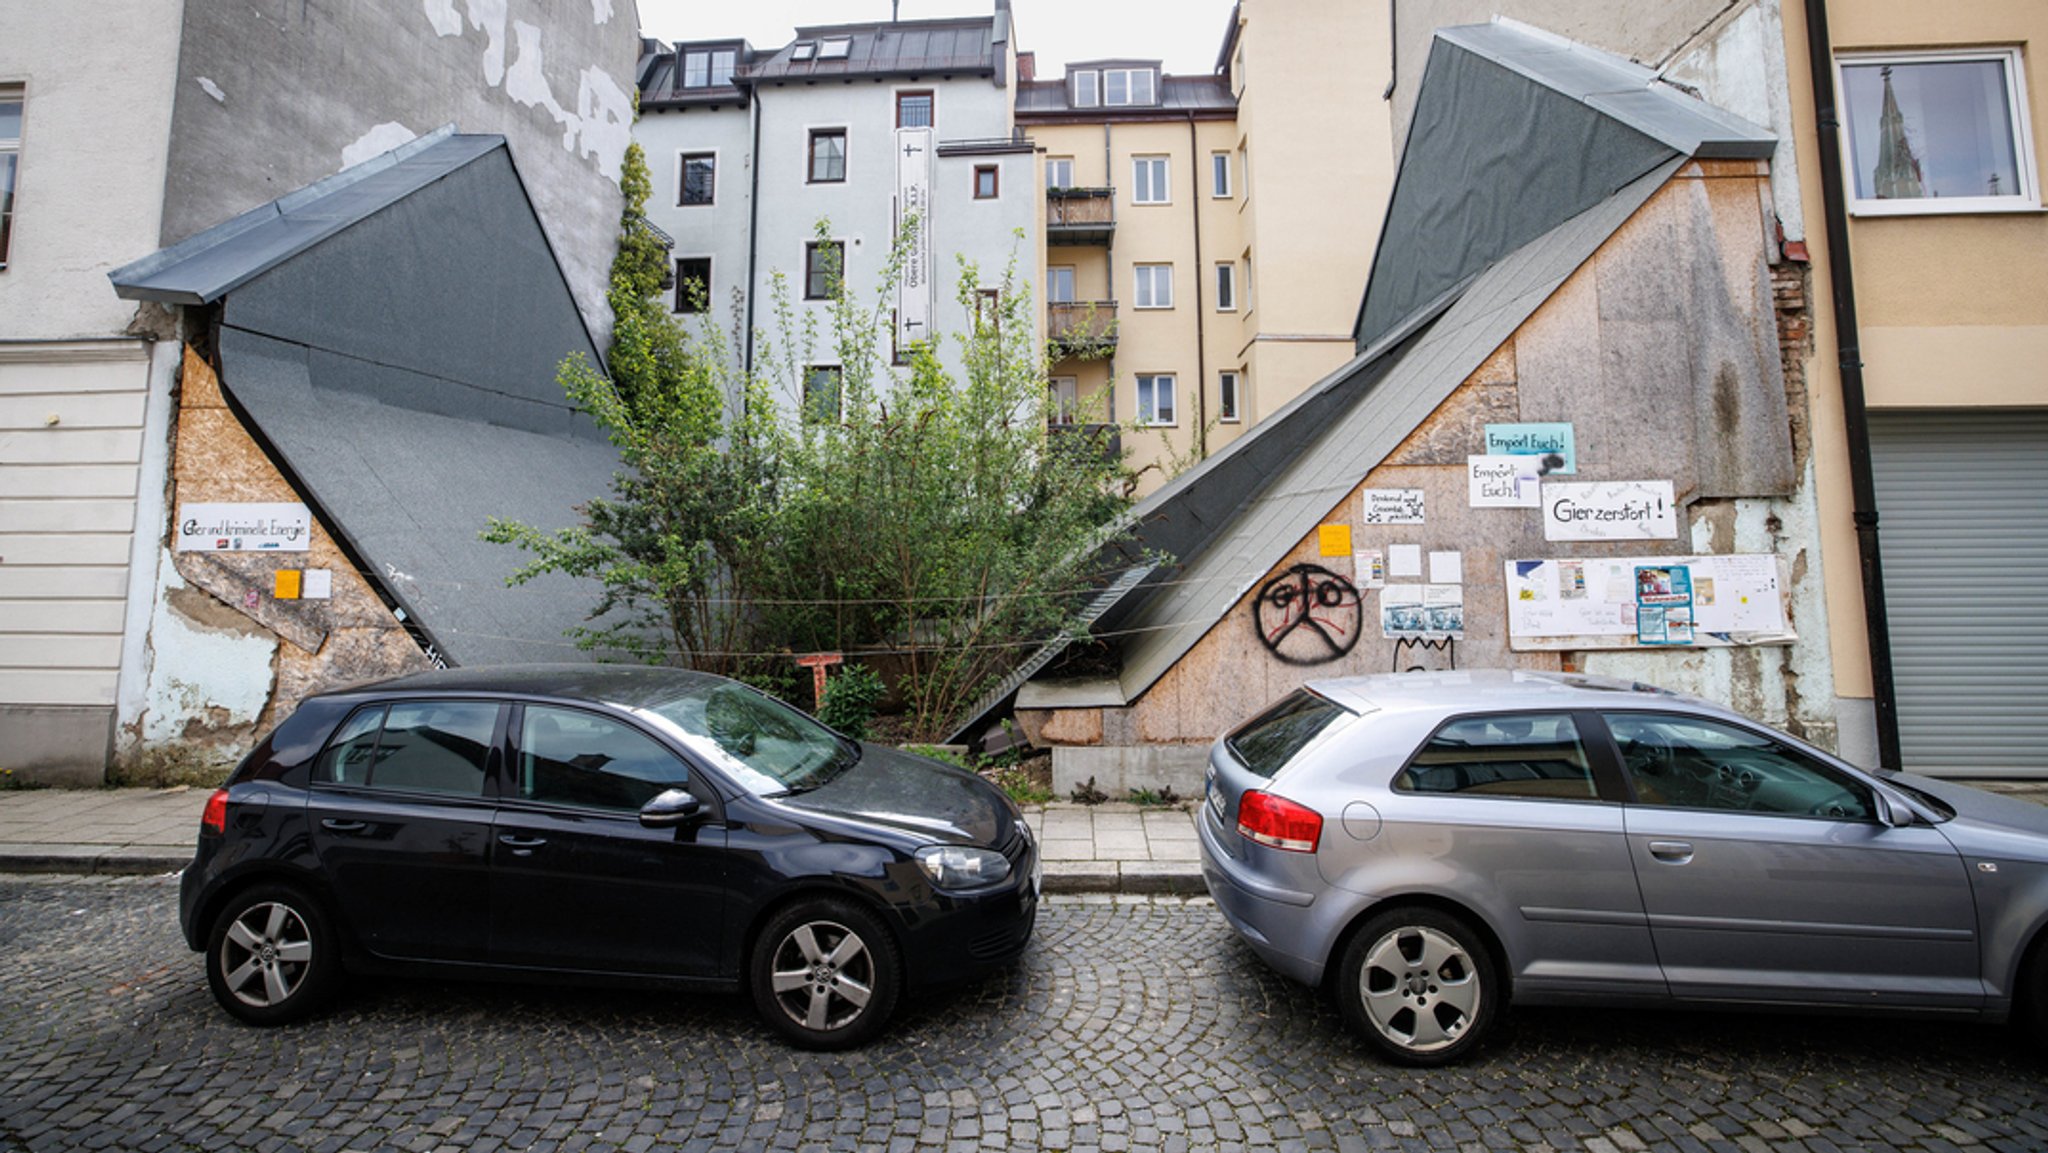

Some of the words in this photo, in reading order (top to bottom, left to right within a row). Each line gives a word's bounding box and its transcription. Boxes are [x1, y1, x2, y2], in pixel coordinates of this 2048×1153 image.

[1489, 433, 1528, 451] Empört
[1531, 432, 1564, 449] Euch!
[1473, 464, 1518, 482] Empört
[207, 519, 224, 535] und
[224, 519, 268, 535] kriminelle
[270, 519, 306, 541] Energie
